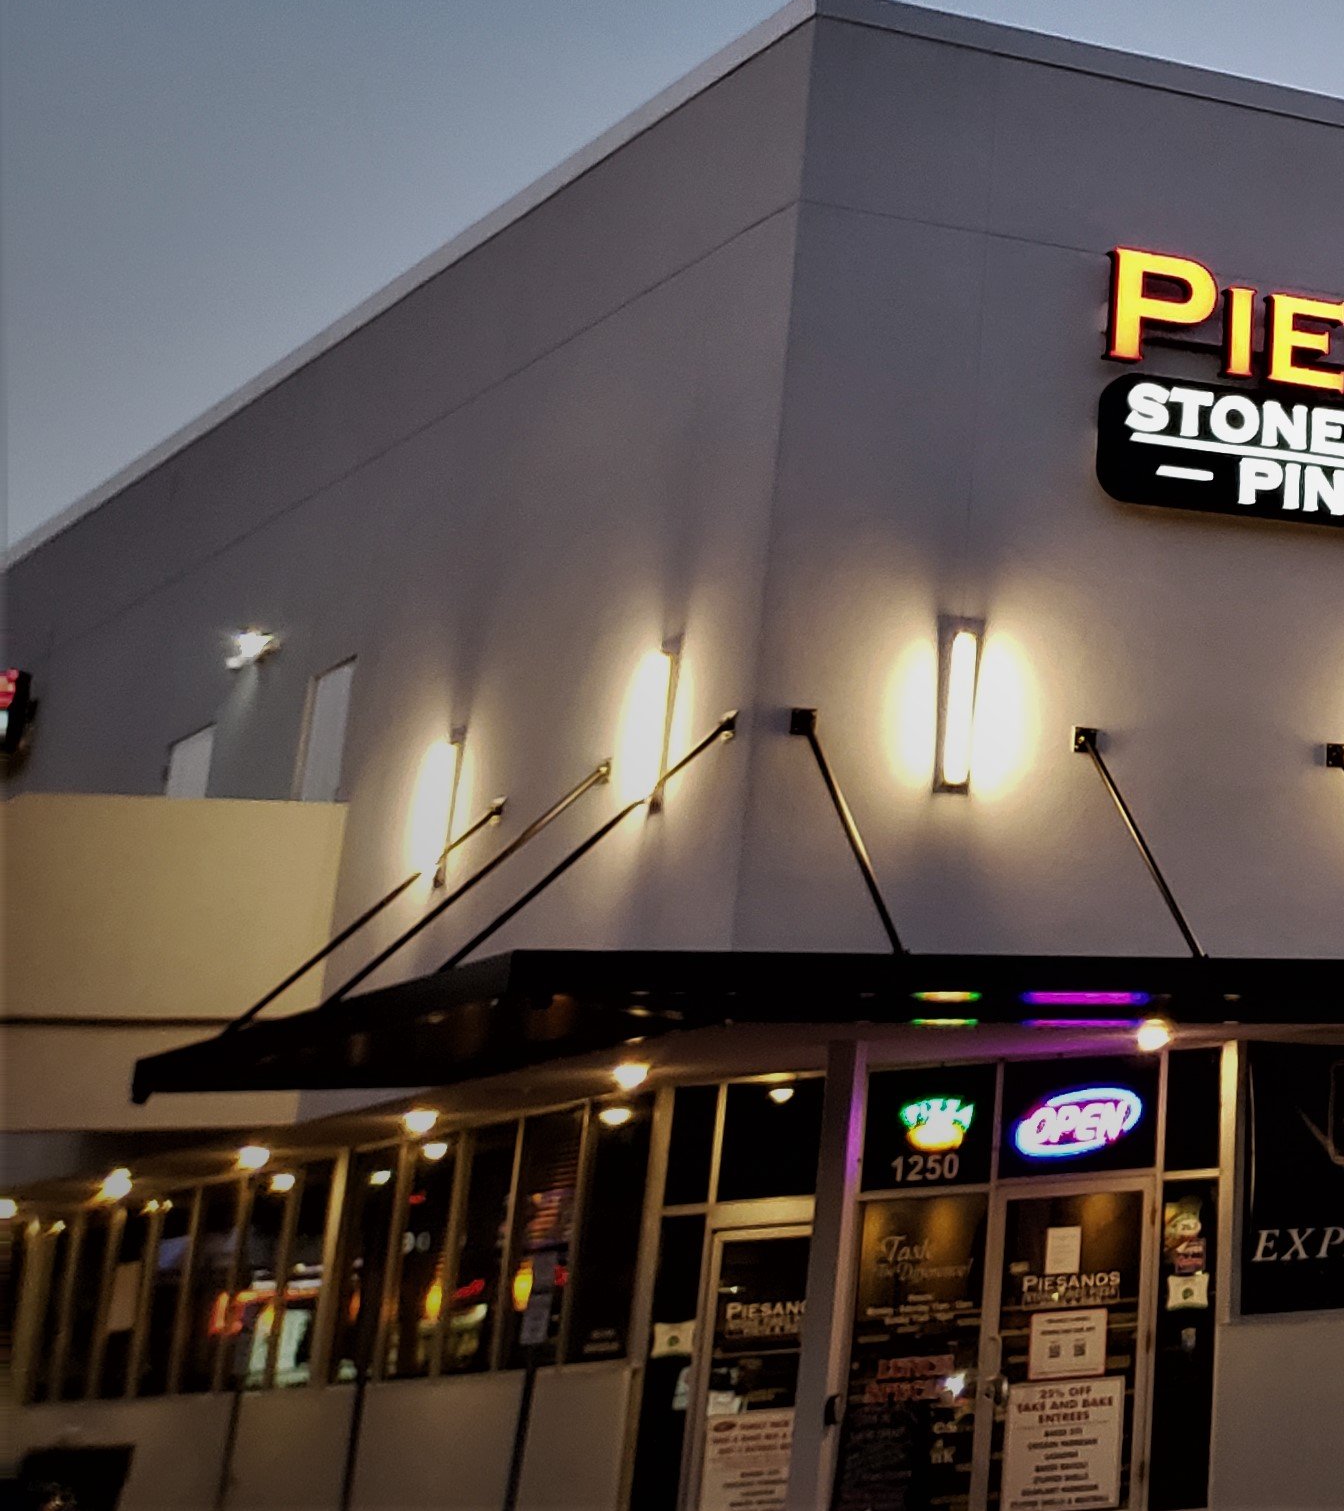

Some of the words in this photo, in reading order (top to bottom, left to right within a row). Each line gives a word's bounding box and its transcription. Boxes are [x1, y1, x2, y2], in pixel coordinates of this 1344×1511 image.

[1023, 1099, 1133, 1144] OPEN
[891, 1152, 960, 1183] 1250
[1022, 1271, 1121, 1293] PIESANOS
[725, 1300, 806, 1320] PIESAN
[1068, 1385, 1092, 1397] OFF
[1049, 1399, 1079, 1411] AND
